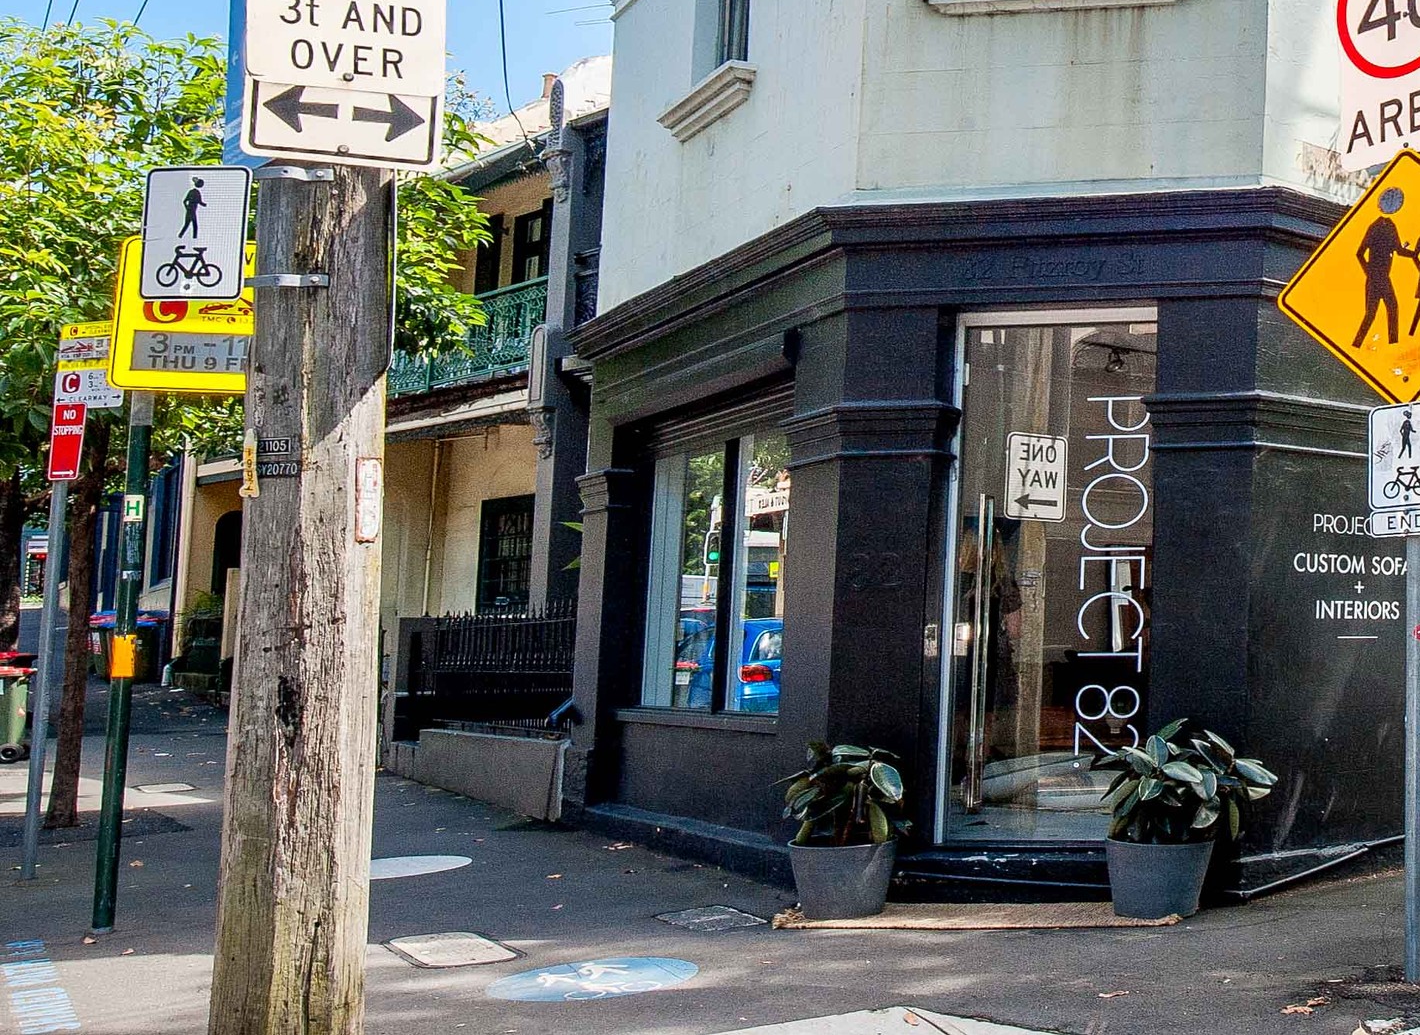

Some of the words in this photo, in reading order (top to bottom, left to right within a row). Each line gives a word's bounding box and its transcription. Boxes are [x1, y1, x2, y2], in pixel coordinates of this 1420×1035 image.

[341, 0, 422, 37] AND
[290, 38, 404, 79] OVER
[147, 354, 196, 369] THU
[203, 356, 217, 370] 9
[63, 409, 77, 420] NO
[54, 426, 83, 436] STOPPING
[126, 500, 140, 516] H
[1077, 396, 1151, 673] PROJECT
[1293, 552, 1366, 575] CUSTOM
[1315, 599, 1400, 621] INTERIORS
